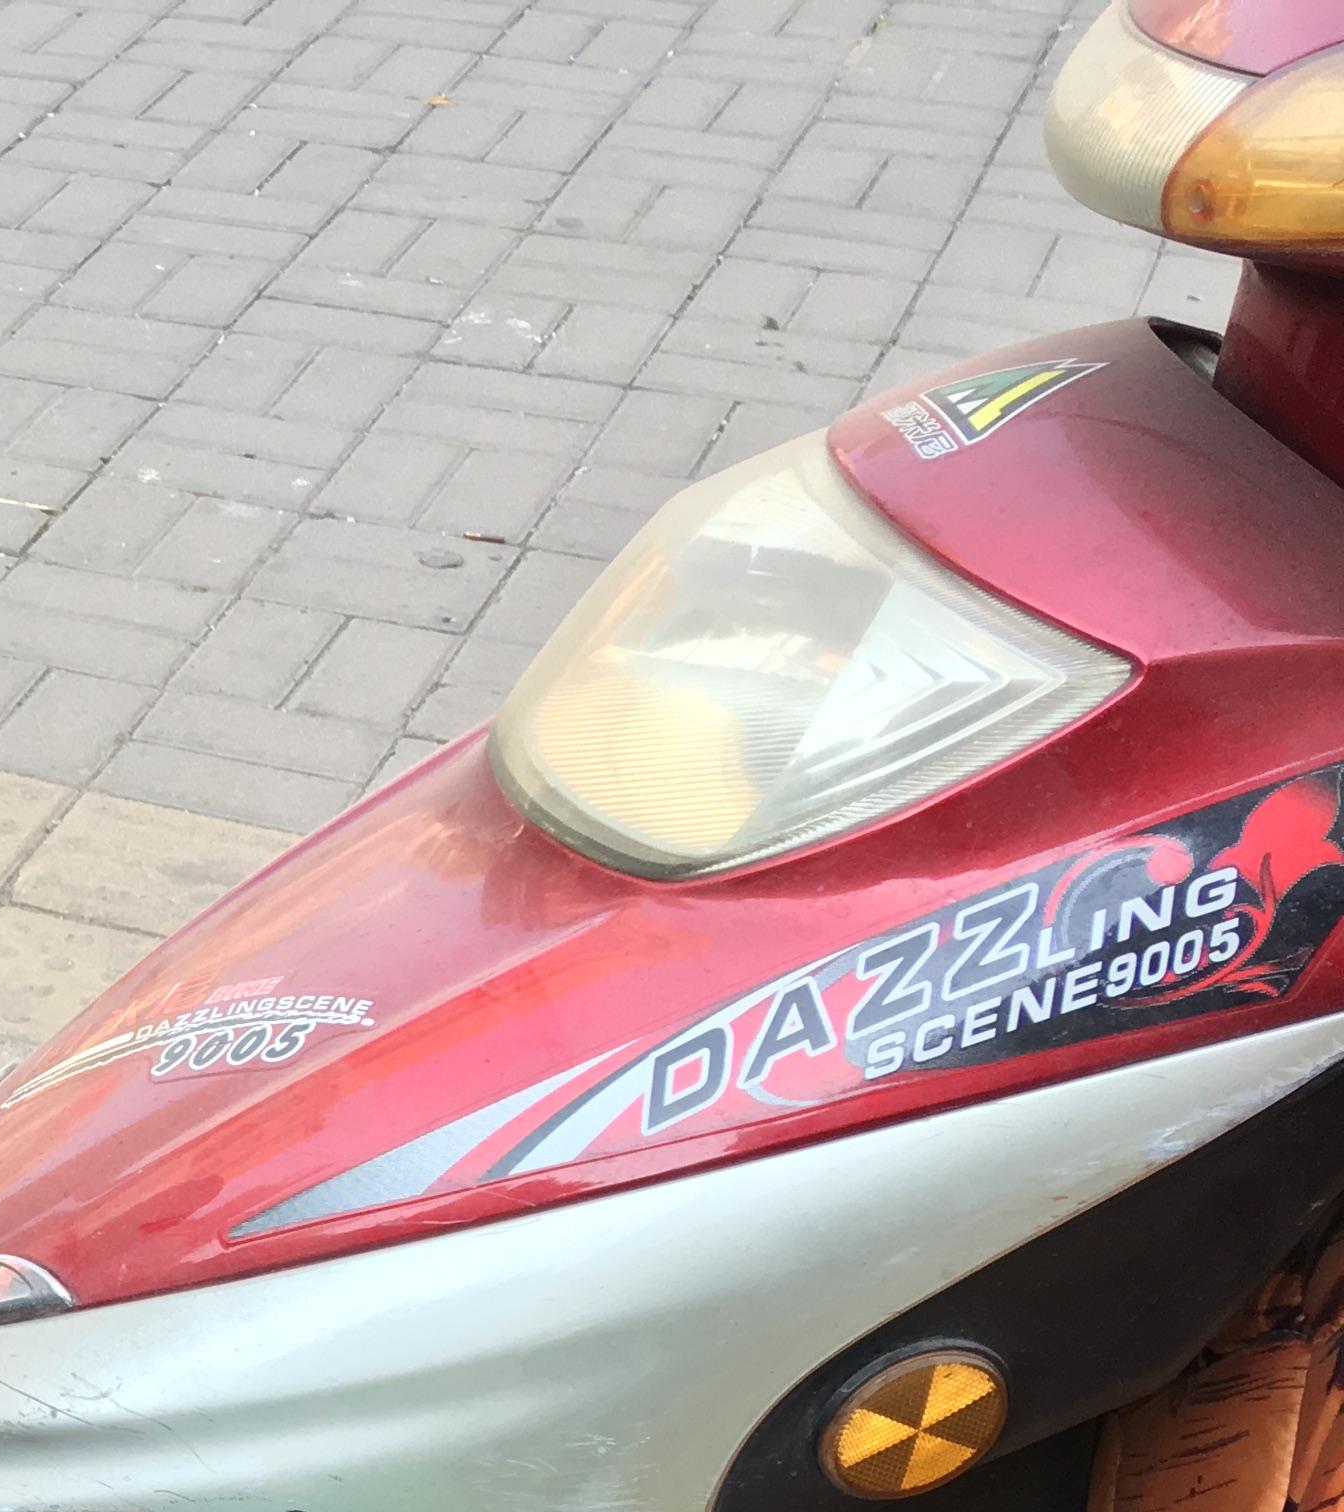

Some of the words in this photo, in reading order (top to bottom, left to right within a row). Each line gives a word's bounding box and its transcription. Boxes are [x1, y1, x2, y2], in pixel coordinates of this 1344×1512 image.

[134, 995, 374, 1041] DAZZLINGSCENE
[151, 1020, 316, 1076] 9005
[641, 867, 1239, 1136] DAZZLING
[862, 917, 1241, 1080] SCENE9005
